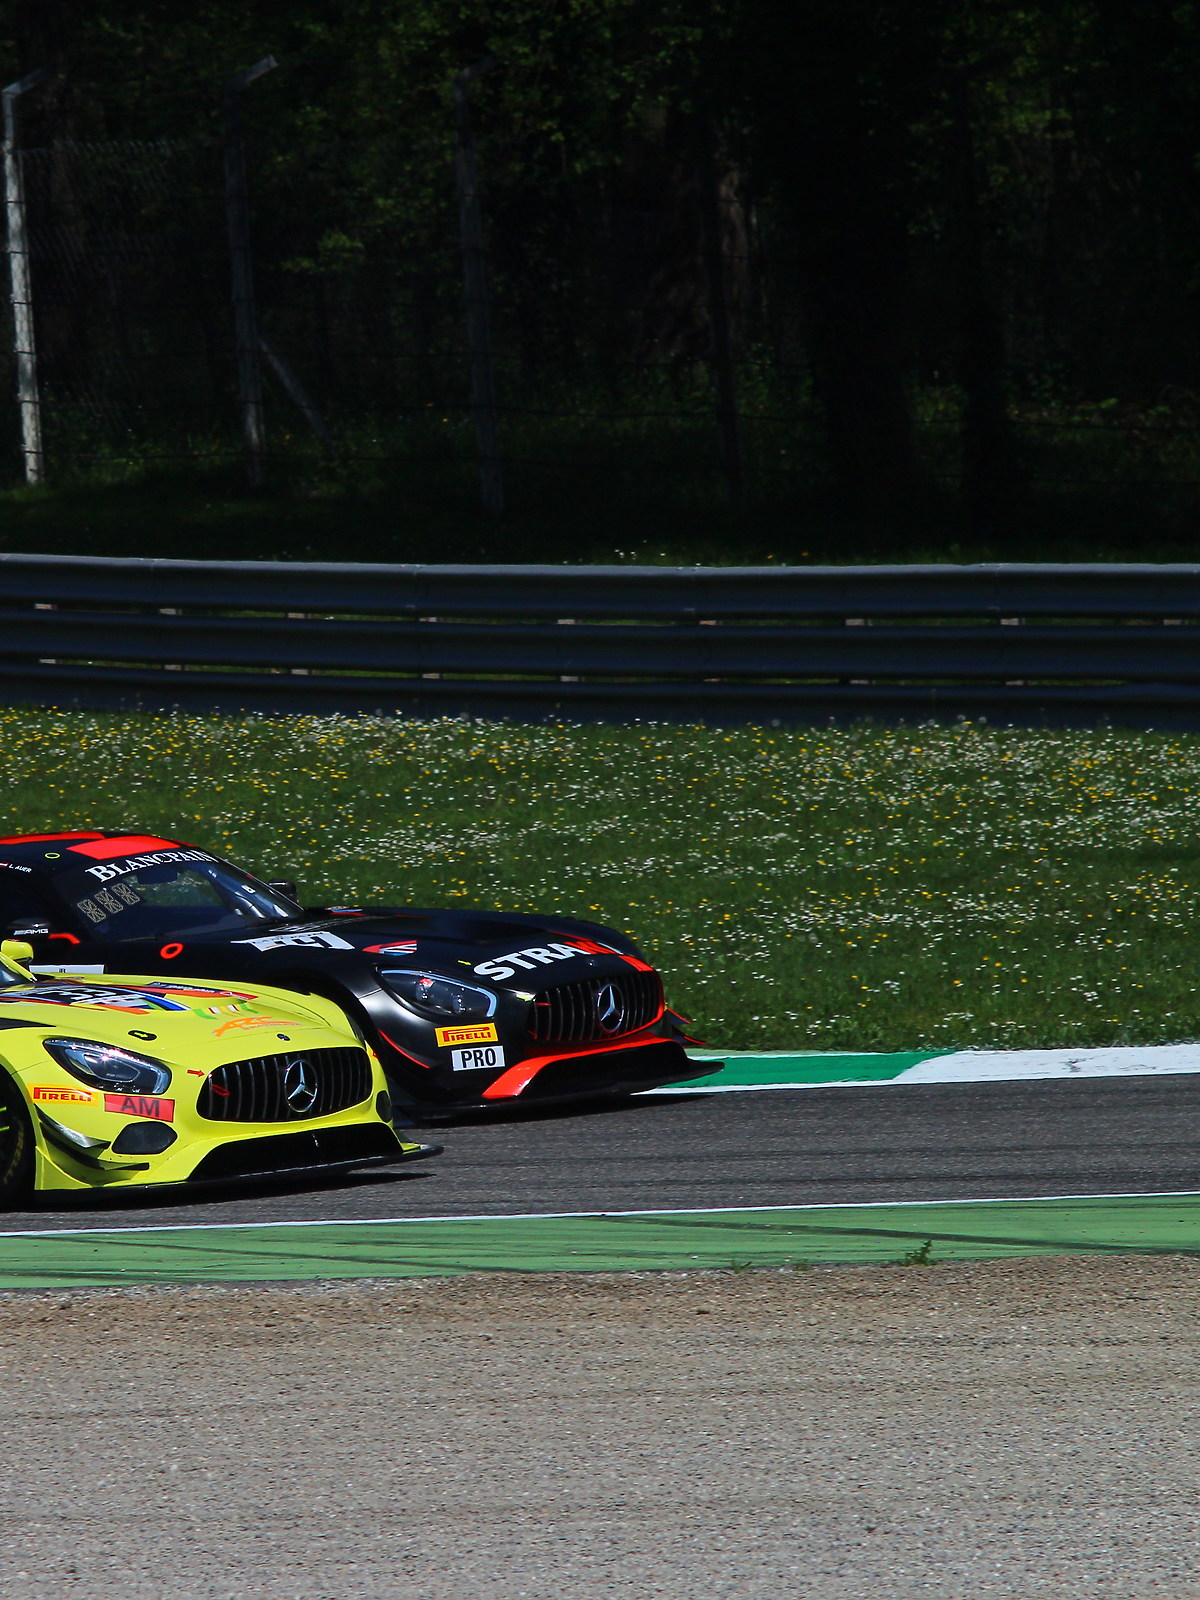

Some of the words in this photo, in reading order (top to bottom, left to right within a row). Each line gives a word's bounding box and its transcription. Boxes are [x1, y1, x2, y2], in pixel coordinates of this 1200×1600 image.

[85, 849, 219, 883] BLANCPAIN
[442, 1026, 492, 1042] PIRELLI
[460, 1048, 497, 1068] PRO
[33, 1087, 92, 1102] PIRELLI
[121, 1097, 160, 1117] AM
